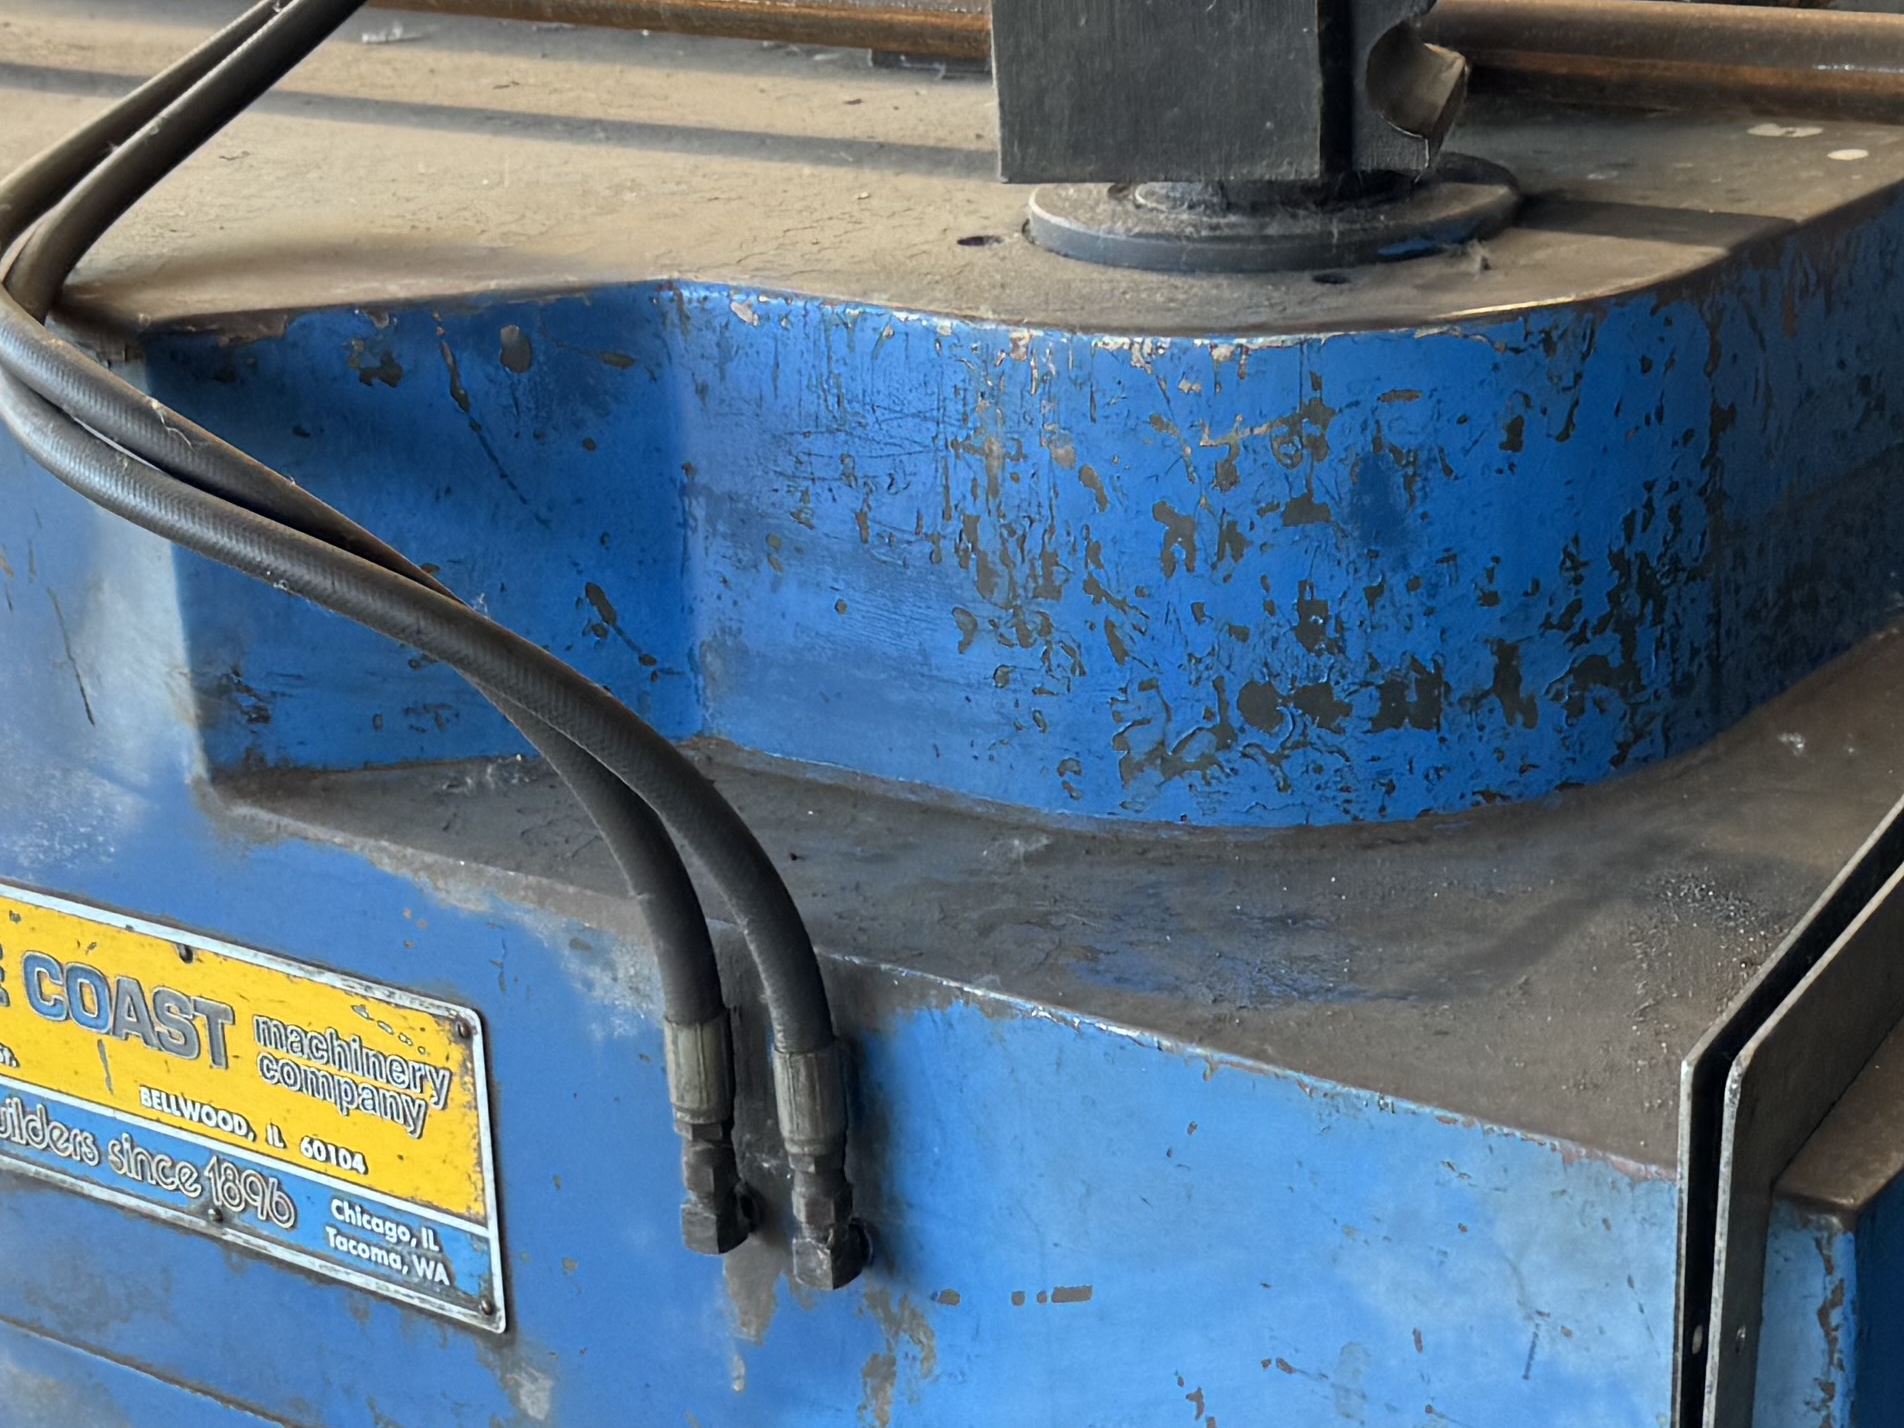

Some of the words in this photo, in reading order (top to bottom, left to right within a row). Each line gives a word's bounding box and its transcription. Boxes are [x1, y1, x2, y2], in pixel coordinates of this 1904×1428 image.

[22, 949, 235, 1069] COAST
[253, 1014, 452, 1110] machinery
[257, 1052, 427, 1139] company
[139, 1085, 257, 1142] BELLWOOD,
[266, 1123, 286, 1148] IL
[300, 1135, 368, 1175] 60104
[108, 1132, 202, 1198] since
[204, 1155, 296, 1229] 1896
[330, 1198, 416, 1247] Chicago,
[421, 1226, 441, 1252] IL
[325, 1226, 408, 1275] Tacoma,
[411, 1254, 450, 1286] WA
